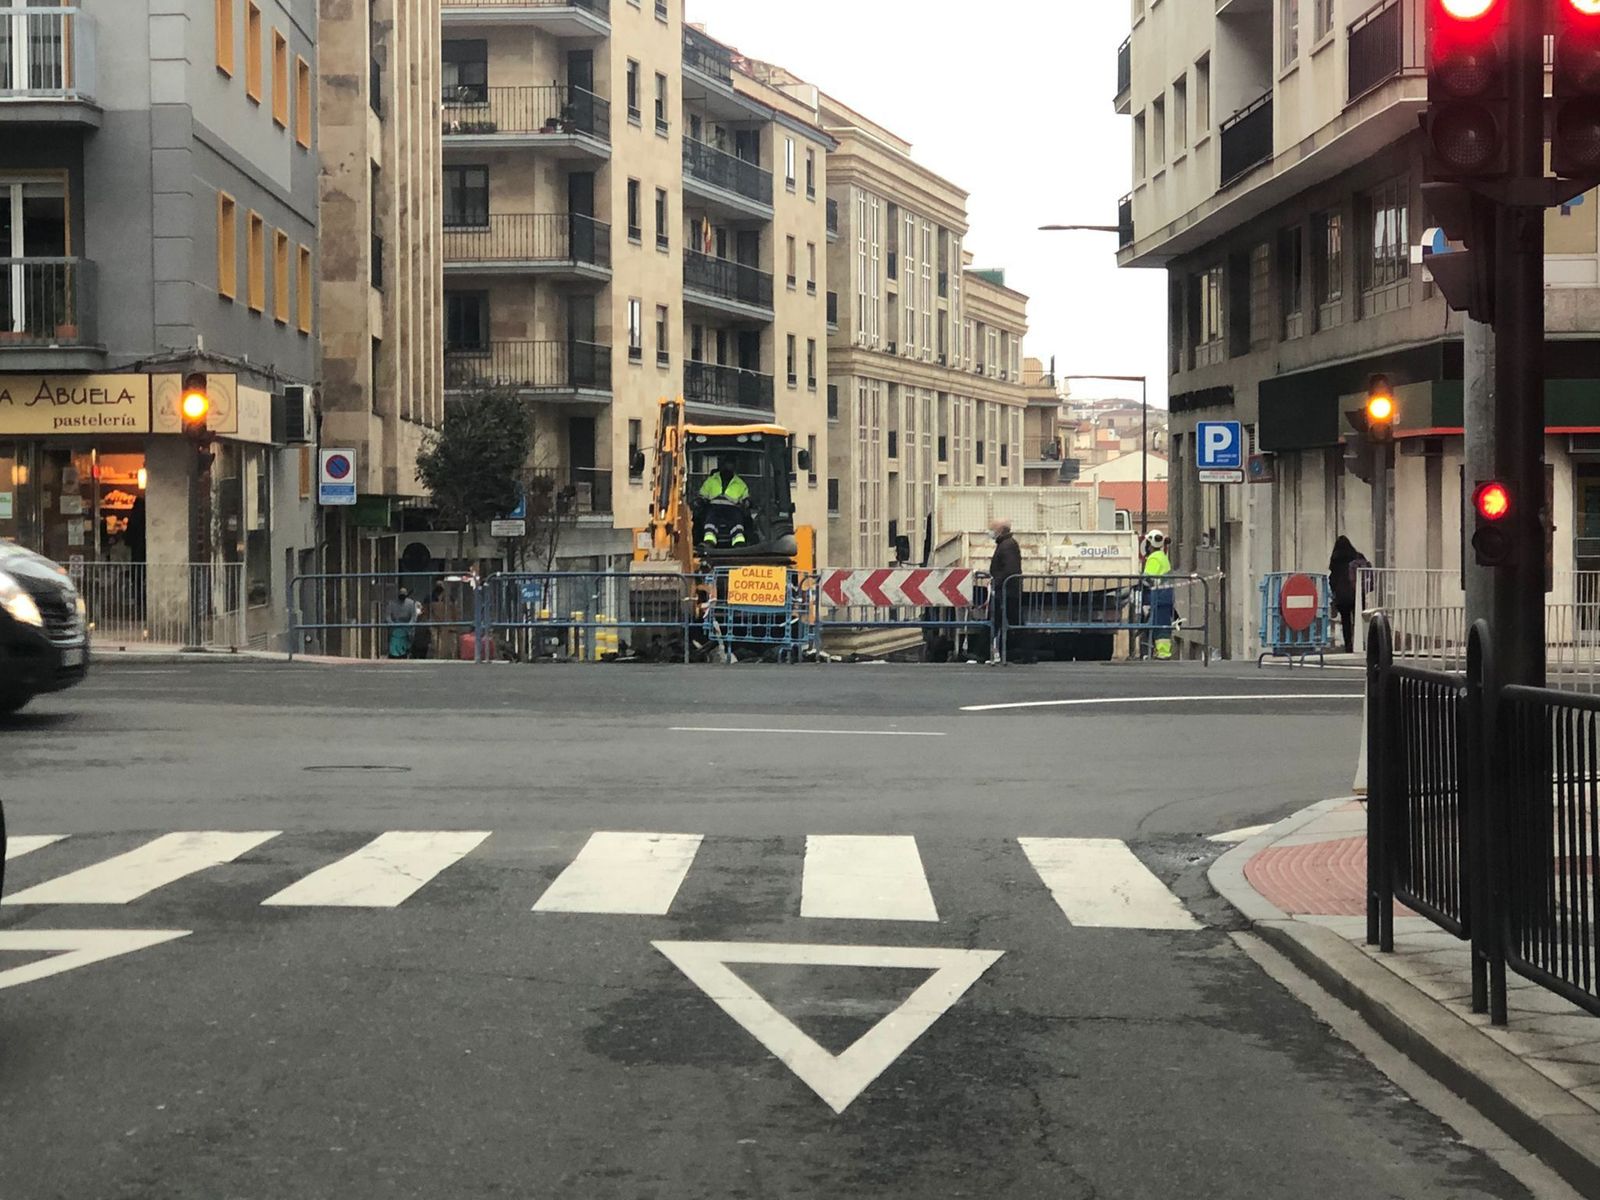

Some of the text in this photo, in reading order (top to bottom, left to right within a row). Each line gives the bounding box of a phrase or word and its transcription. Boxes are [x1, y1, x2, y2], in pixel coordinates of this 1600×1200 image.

[24, 379, 135, 407] ABUELA
[53, 413, 136, 429] pastelería
[1205, 426, 1232, 463] P
[1080, 545, 1119, 558] aqualia
[741, 568, 774, 578] CALLE
[733, 580, 780, 591] CORTADA
[728, 591, 785, 603] POR OBRAS
